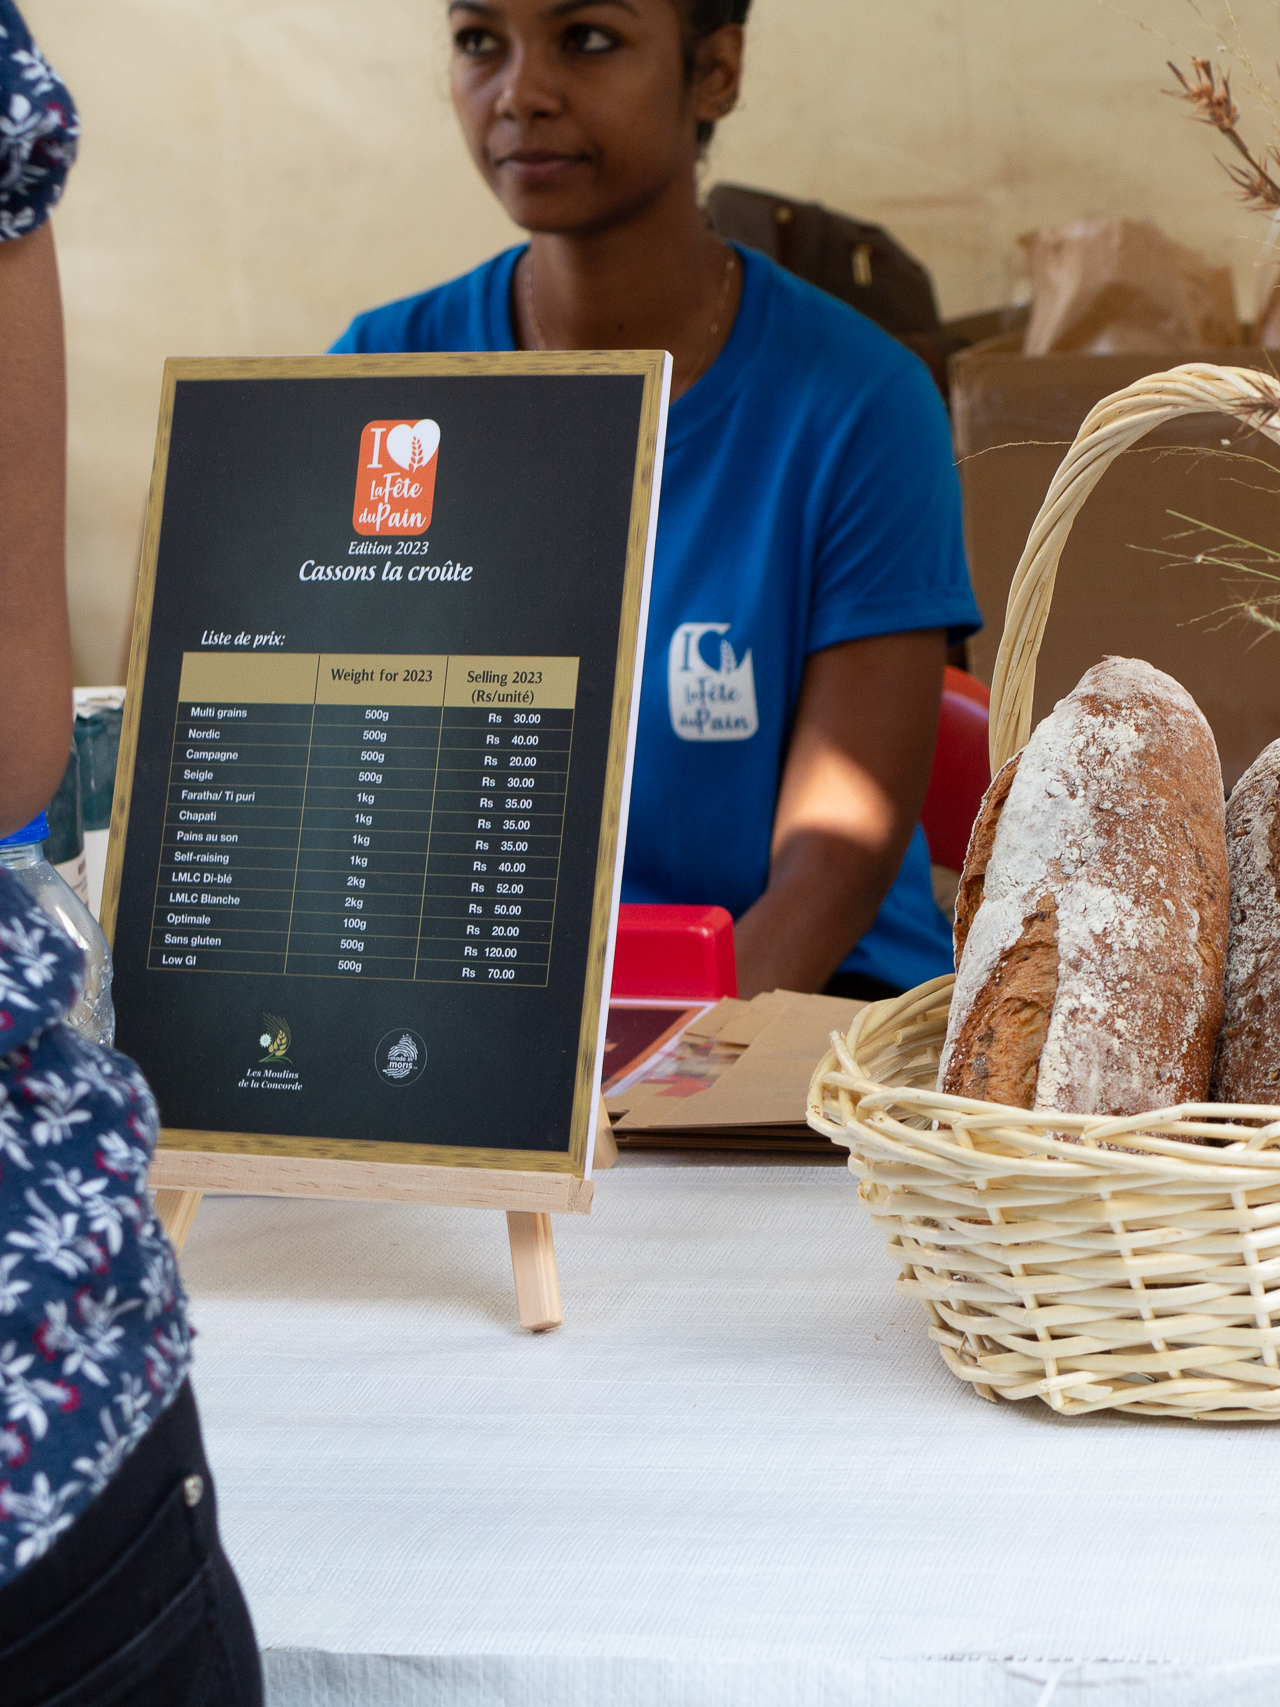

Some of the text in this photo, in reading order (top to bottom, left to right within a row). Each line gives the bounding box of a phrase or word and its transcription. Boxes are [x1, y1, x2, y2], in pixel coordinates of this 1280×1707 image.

[367, 427, 387, 469] I
[383, 472, 424, 504] Fête
[375, 502, 427, 532] Pain
[349, 542, 429, 555] Edition 2023
[299, 560, 473, 581] Cassons la croûte
[201, 631, 285, 648] Liste de prix:
[331, 669, 432, 684] Weight for 2023
[467, 671, 542, 686] Selling 2023
[472, 690, 534, 705] (Rs/unité)
[191, 707, 247, 719] Multi grains
[365, 710, 389, 721] 500g
[489, 713, 540, 723] Rs 30.00
[189, 729, 220, 738] Nordic
[363, 731, 386, 742] 500g
[487, 735, 538, 745] Rs 40.00
[186, 749, 238, 761] Campagne
[361, 751, 384, 763] 500g
[484, 756, 536, 766] Rs 20.00
[184, 770, 213, 781] Seigle
[359, 772, 382, 784] 500g
[482, 777, 534, 787] Rs 30.00
[182, 790, 255, 803] Faratha/ Ti puri
[357, 793, 374, 804] 1kg
[480, 798, 532, 809] Rs 35.00
[180, 810, 216, 822] Chapati
[355, 814, 372, 825] 1kg
[478, 819, 530, 830] Rs 35.00
[177, 831, 203, 841] Pains
[353, 835, 370, 846] 1kg
[476, 840, 528, 851] Rs 35.00
[175, 852, 229, 864] Self-raising
[351, 855, 367, 867] 1kg
[474, 861, 525, 872] Rs 40.00
[172, 872, 232, 883] LMLC Di-blé
[347, 876, 365, 888] 2kg
[471, 883, 523, 893] Rs 52.00
[170, 893, 240, 904] LMLC Blanche
[345, 897, 363, 909] 2kg
[469, 904, 521, 915] Rs 50.00
[167, 913, 210, 925] Optimale
[344, 918, 366, 930] 100g
[467, 925, 519, 936] Rs 20.00
[165, 934, 221, 946] Sans gluten
[340, 939, 364, 951] 500g
[465, 946, 517, 957] Rs 120.00
[162, 955, 196, 965] Low GI
[338, 960, 361, 972] 500g
[462, 968, 514, 979] Rs 70.00
[246, 1068, 299, 1079] Les Moulins
[237, 1078, 303, 1091] de la Concorde
